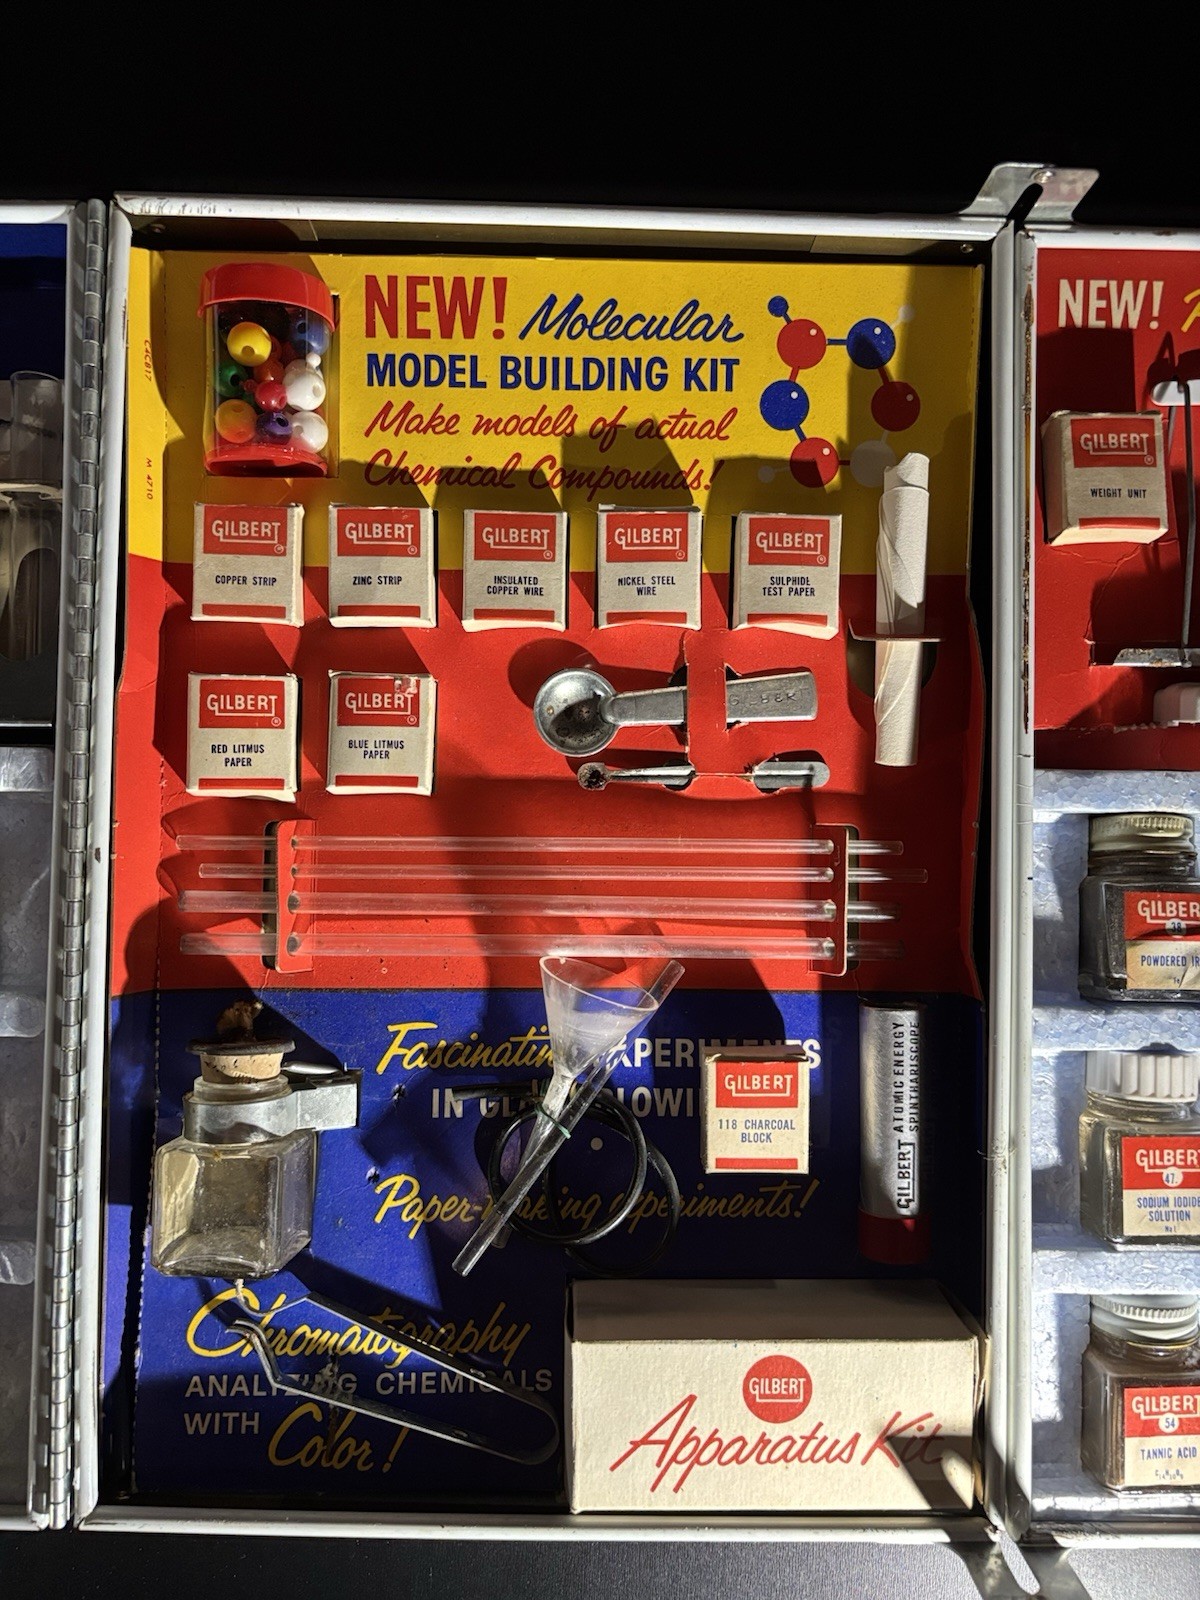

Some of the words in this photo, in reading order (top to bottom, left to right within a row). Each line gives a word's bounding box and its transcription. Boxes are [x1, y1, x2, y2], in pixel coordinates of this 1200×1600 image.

[365, 274, 508, 340] NEW!
[519, 293, 744, 342] Molecular
[1058, 278, 1164, 330] NEW!
[366, 353, 487, 389] MODEL
[500, 356, 668, 391] BUILDING
[684, 357, 740, 392] KIT
[364, 400, 460, 438] Make
[472, 404, 578, 438] models
[589, 405, 628, 452] of
[635, 407, 738, 441] actual
[1080, 433, 1150, 456] GILBERT
[364, 448, 522, 490] Chemical
[527, 455, 725, 502] Compounds!
[1090, 488, 1122, 498] WEIGHT
[1127, 488, 1147, 499] UNIT
[211, 519, 281, 544] GILBERT
[345, 522, 414, 546] GILBERT
[482, 526, 550, 550] GILBERT
[614, 526, 682, 550] GILBERT
[755, 530, 824, 555] GILBERT
[215, 575, 247, 585] COPPER
[252, 576, 277, 586] STRIP
[352, 575, 372, 585] ZINC
[377, 575, 403, 585] STRIP
[486, 586, 519, 596] COPPER
[524, 586, 544, 596] WIRE
[493, 575, 539, 585] INSULATED
[618, 576, 646, 587] NICKEL
[651, 576, 676, 586] STEEL
[636, 586, 657, 596] WIRE
[762, 586, 783, 597] TEST
[788, 587, 816, 597] PAPER
[770, 575, 811, 586] SULPHIDE
[206, 693, 278, 717] GILBERT
[345, 692, 414, 715] GILBERT
[211, 744, 228, 754] RED
[233, 744, 265, 754] LITMUS
[348, 739, 369, 749] BLUE
[374, 740, 404, 749] LITMUS
[363, 750, 390, 759] PAPER
[224, 757, 252, 767] PAPER
[1137, 899, 1200, 924] GILBER
[1141, 955, 1187, 967] POWDERED
[1191, 955, 1200, 967] IR
[375, 1021, 554, 1075] Fascinatin
[892, 1021, 905, 1076] ENERGY
[724, 1074, 794, 1097] GILBERT
[909, 1021, 920, 1132] SPINTHARISCOPE
[892, 1081, 905, 1133] ATOMIC
[718, 1119, 738, 1130] 118
[744, 1119, 796, 1131] CHARCOAL
[741, 1132, 772, 1143] BLOCK
[1135, 1149, 1200, 1173] GILBER
[896, 1139, 916, 1209] GILBERT
[1137, 1197, 1170, 1208] SODIUM
[1149, 1210, 1191, 1222] SOLUTION
[749, 1376, 807, 1402] GILBERT
[183, 1411, 260, 1436] WITH
[1165, 1417, 1175, 1429] 54
[609, 1394, 861, 1494] Apparatus
[861, 1411, 945, 1468] Kit
[1140, 1447, 1172, 1460] TANNIC
[1177, 1446, 1197, 1459] ACID
